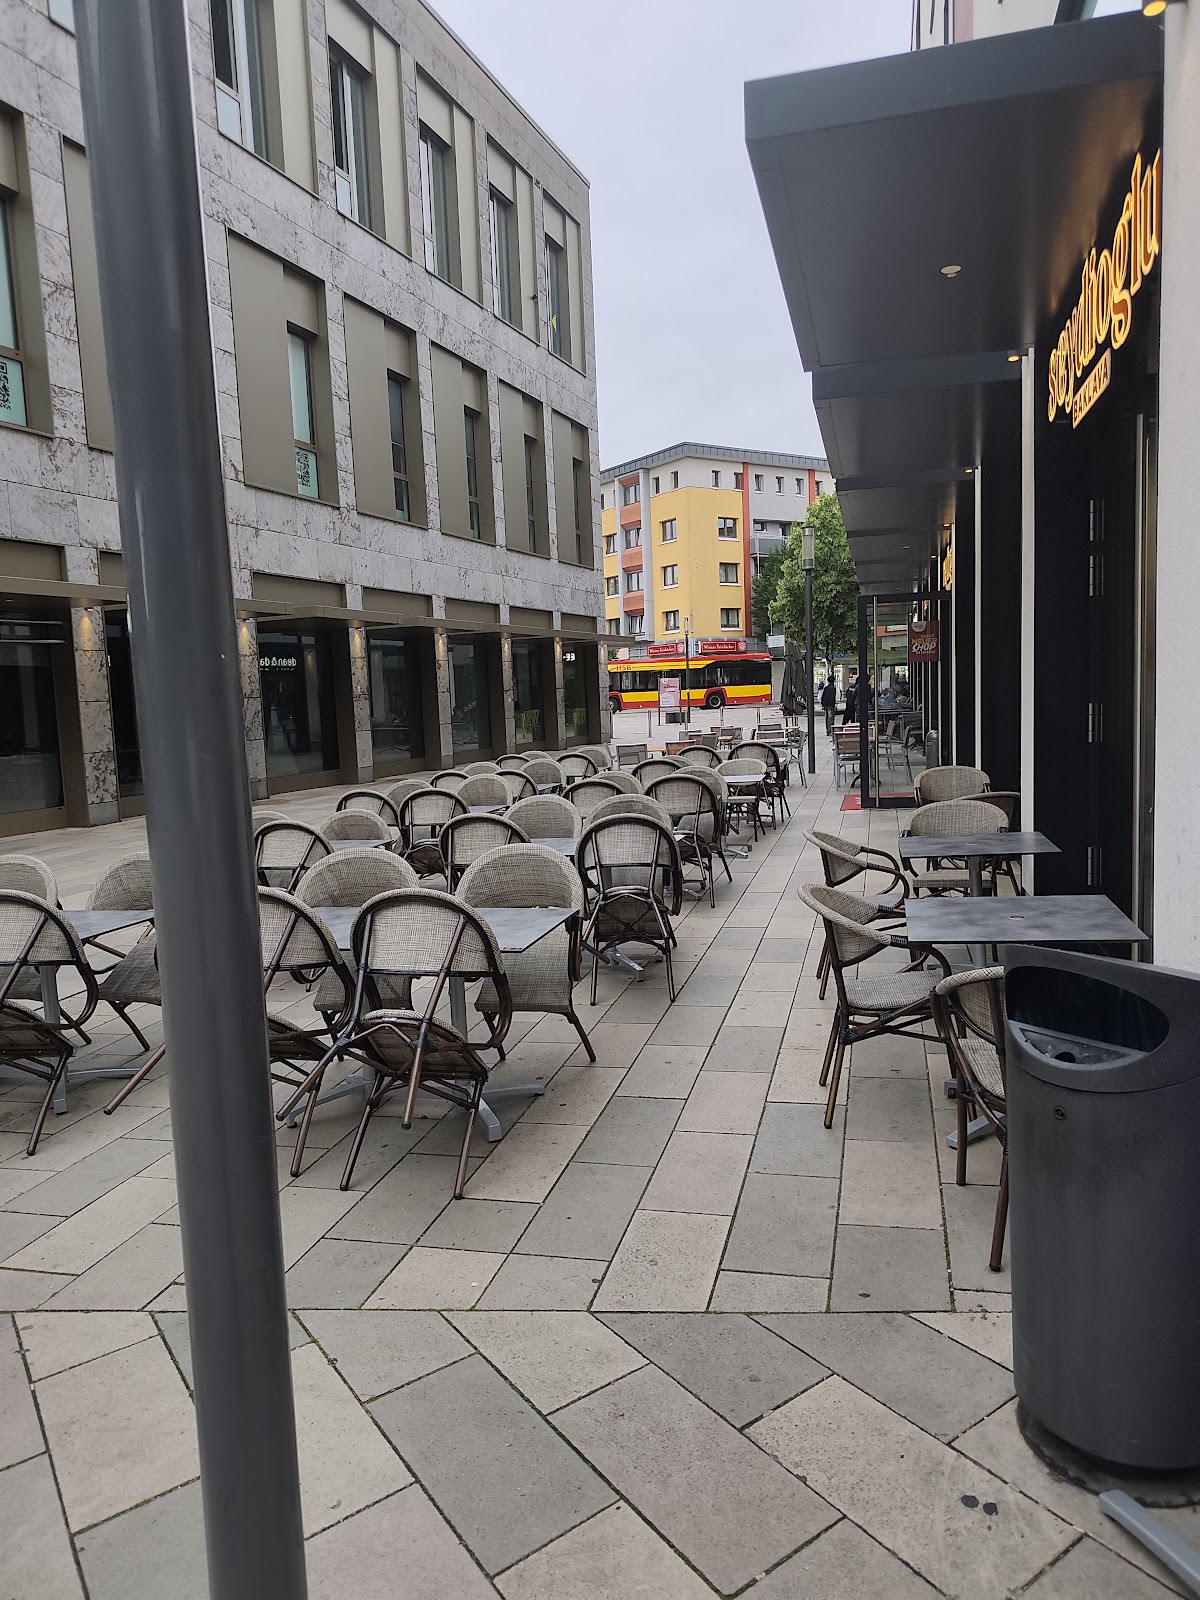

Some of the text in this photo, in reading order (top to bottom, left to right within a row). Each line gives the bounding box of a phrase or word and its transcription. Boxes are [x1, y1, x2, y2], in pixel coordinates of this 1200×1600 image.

[1072, 355, 1109, 425] BAKLAVA
[911, 637, 938, 645] NEUER
[911, 642, 936, 653] SHOP
